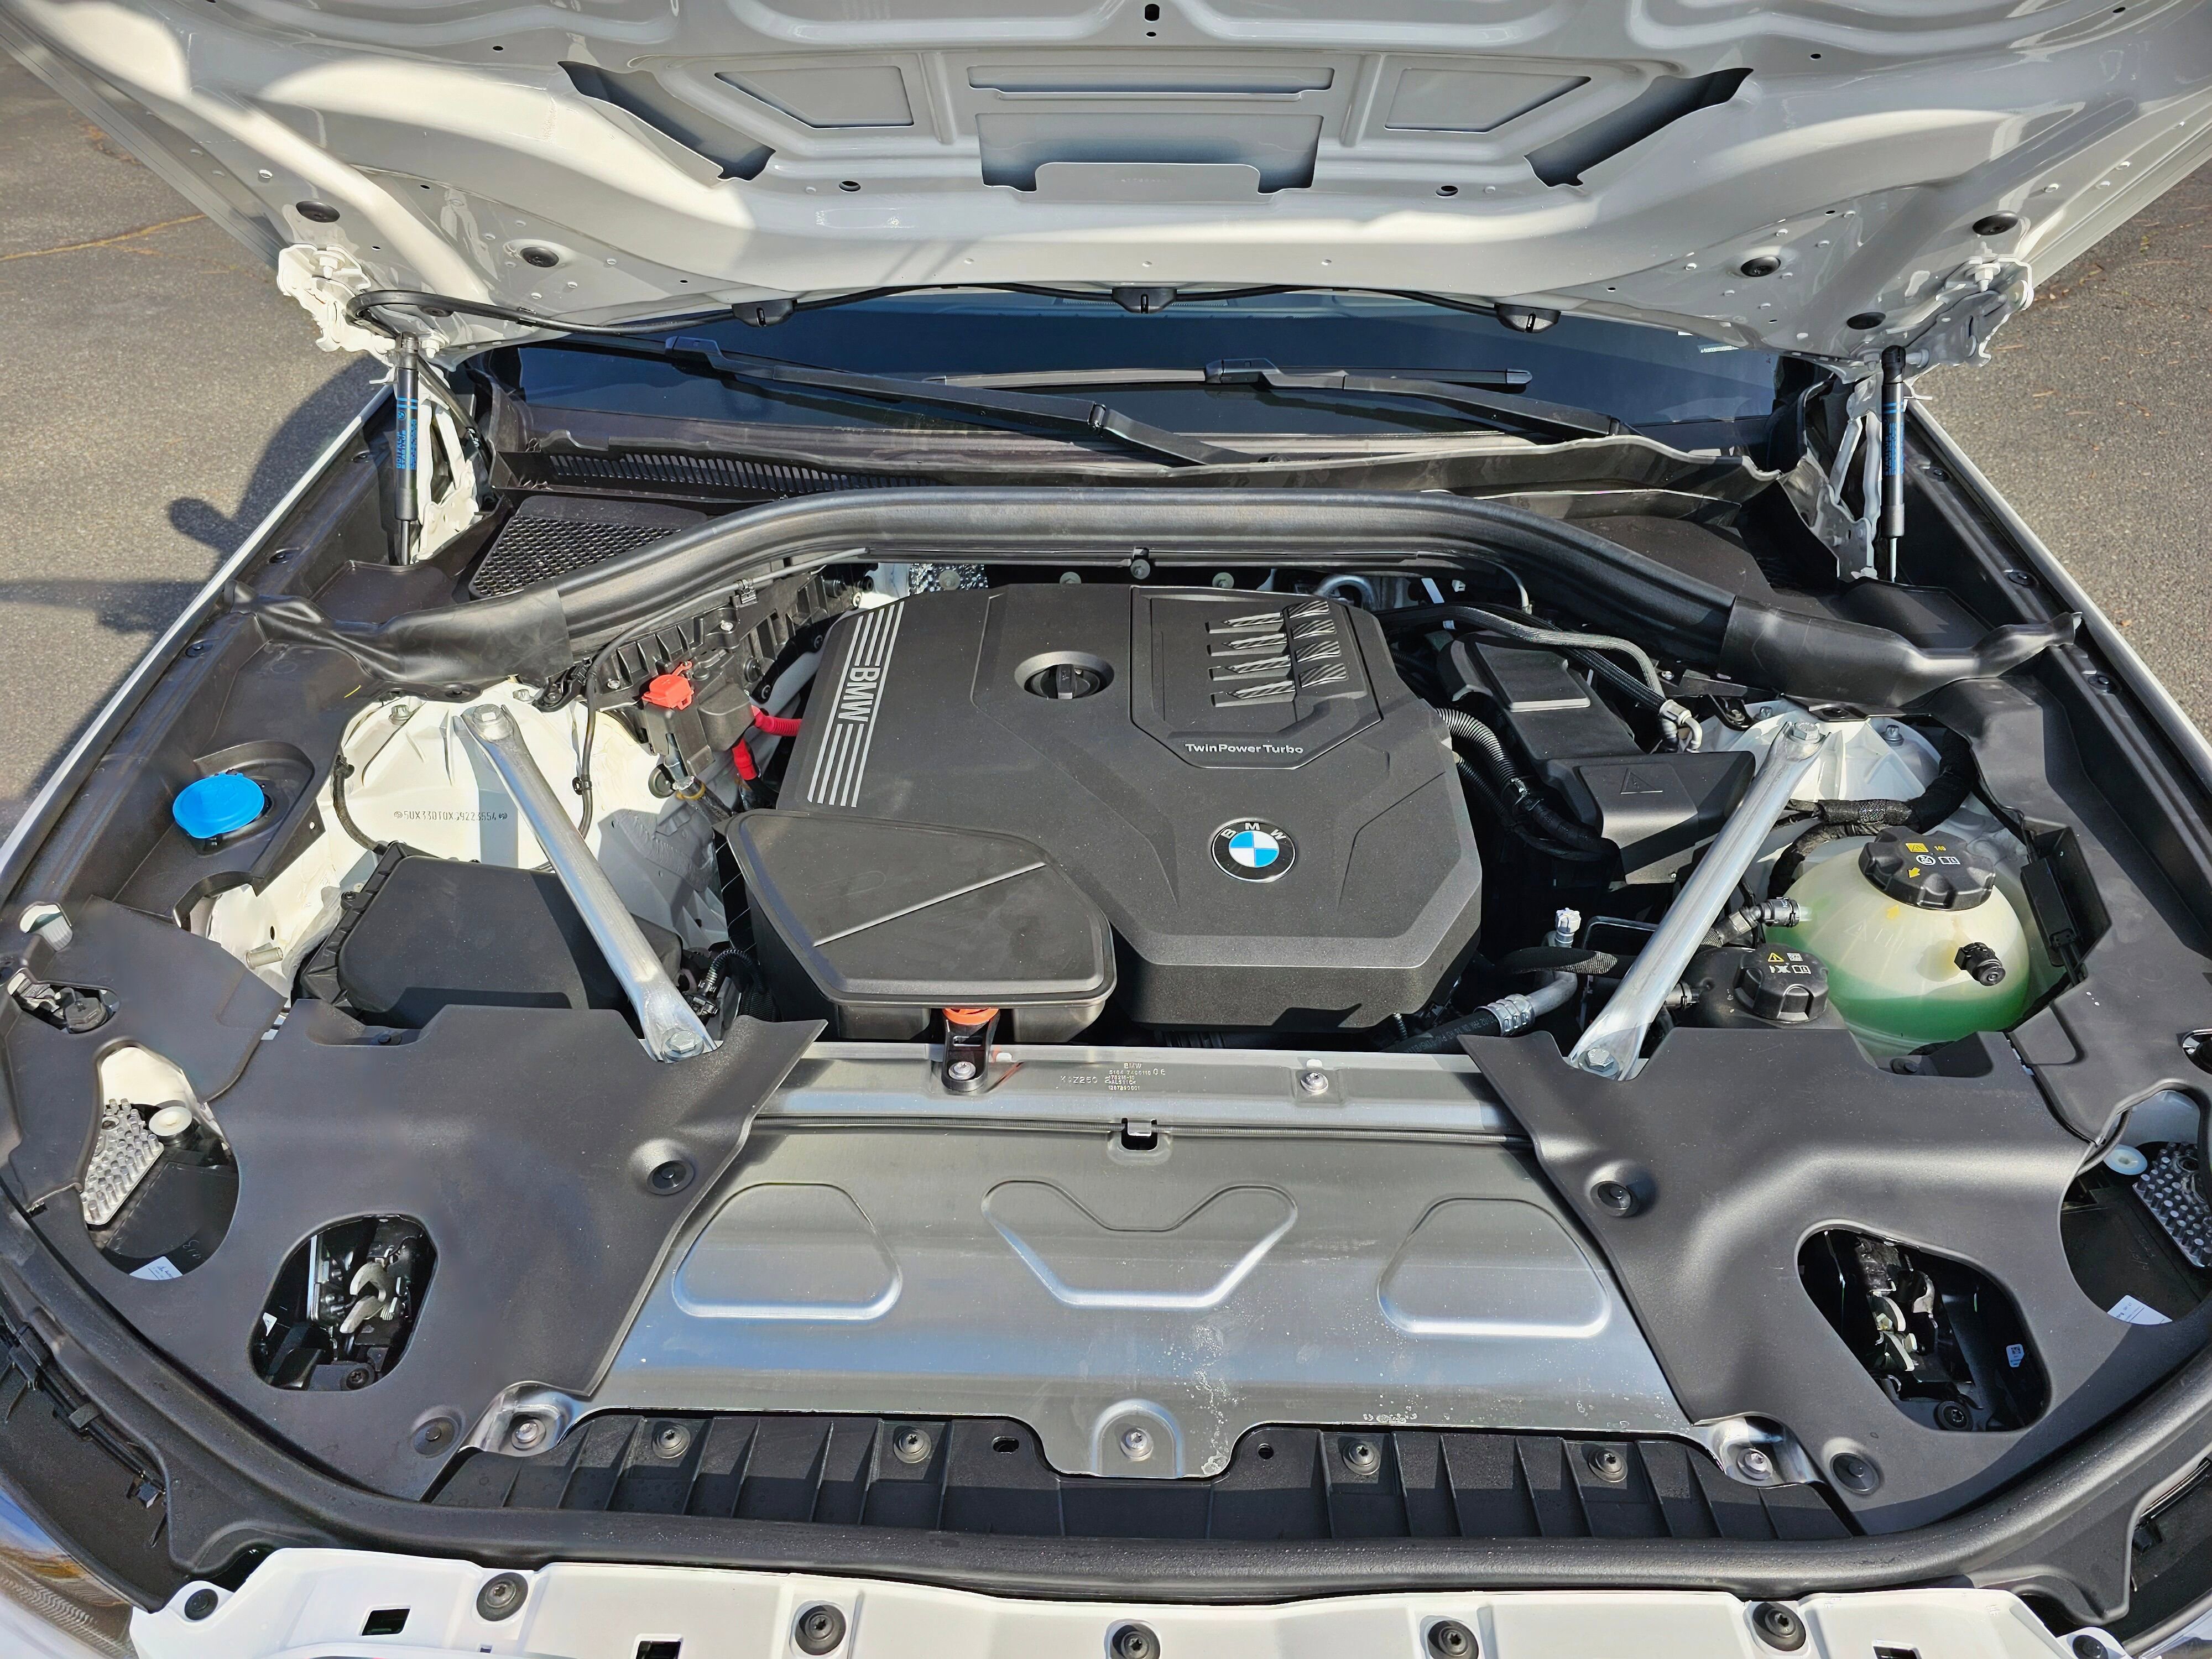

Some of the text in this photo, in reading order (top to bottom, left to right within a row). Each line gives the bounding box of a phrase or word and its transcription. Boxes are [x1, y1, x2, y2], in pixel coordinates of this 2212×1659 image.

[838, 667, 881, 722] BMW
[1185, 744, 1304, 754] TwinPower Turbo
[1220, 822, 1287, 840] BMW
